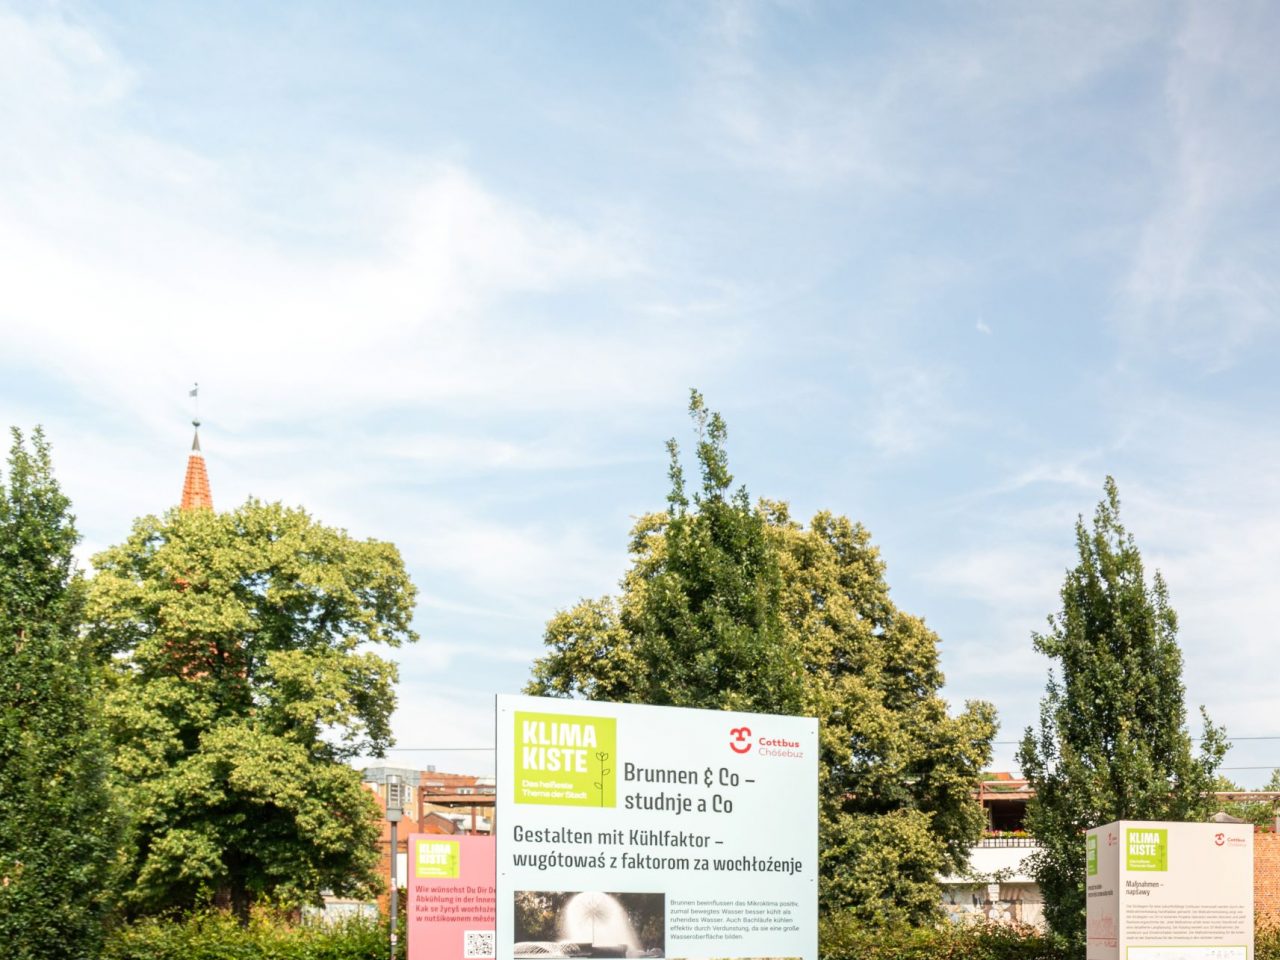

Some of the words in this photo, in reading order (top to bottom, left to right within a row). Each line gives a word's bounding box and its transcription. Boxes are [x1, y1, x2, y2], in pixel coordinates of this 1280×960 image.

[522, 720, 597, 748] KLIMA
[758, 737, 800, 748] Cottbus
[522, 747, 588, 773] KISTE
[623, 762, 699, 785] Brunnen
[704, 767, 713, 789] &
[718, 768, 739, 787] Co
[624, 792, 692, 816] studnje
[697, 799, 707, 812] a
[712, 794, 733, 814] Co
[513, 825, 592, 844] Gestalten
[598, 829, 624, 845] mit
[629, 829, 710, 848] Kühlfaktor
[1130, 832, 1160, 844] KLIMA
[1130, 844, 1156, 856] KISTE
[513, 851, 605, 870] wugótowaś
[610, 856, 617, 868] z
[622, 852, 689, 870] faktorom
[694, 858, 709, 870] za
[714, 856, 802, 876] wochłoźenje
